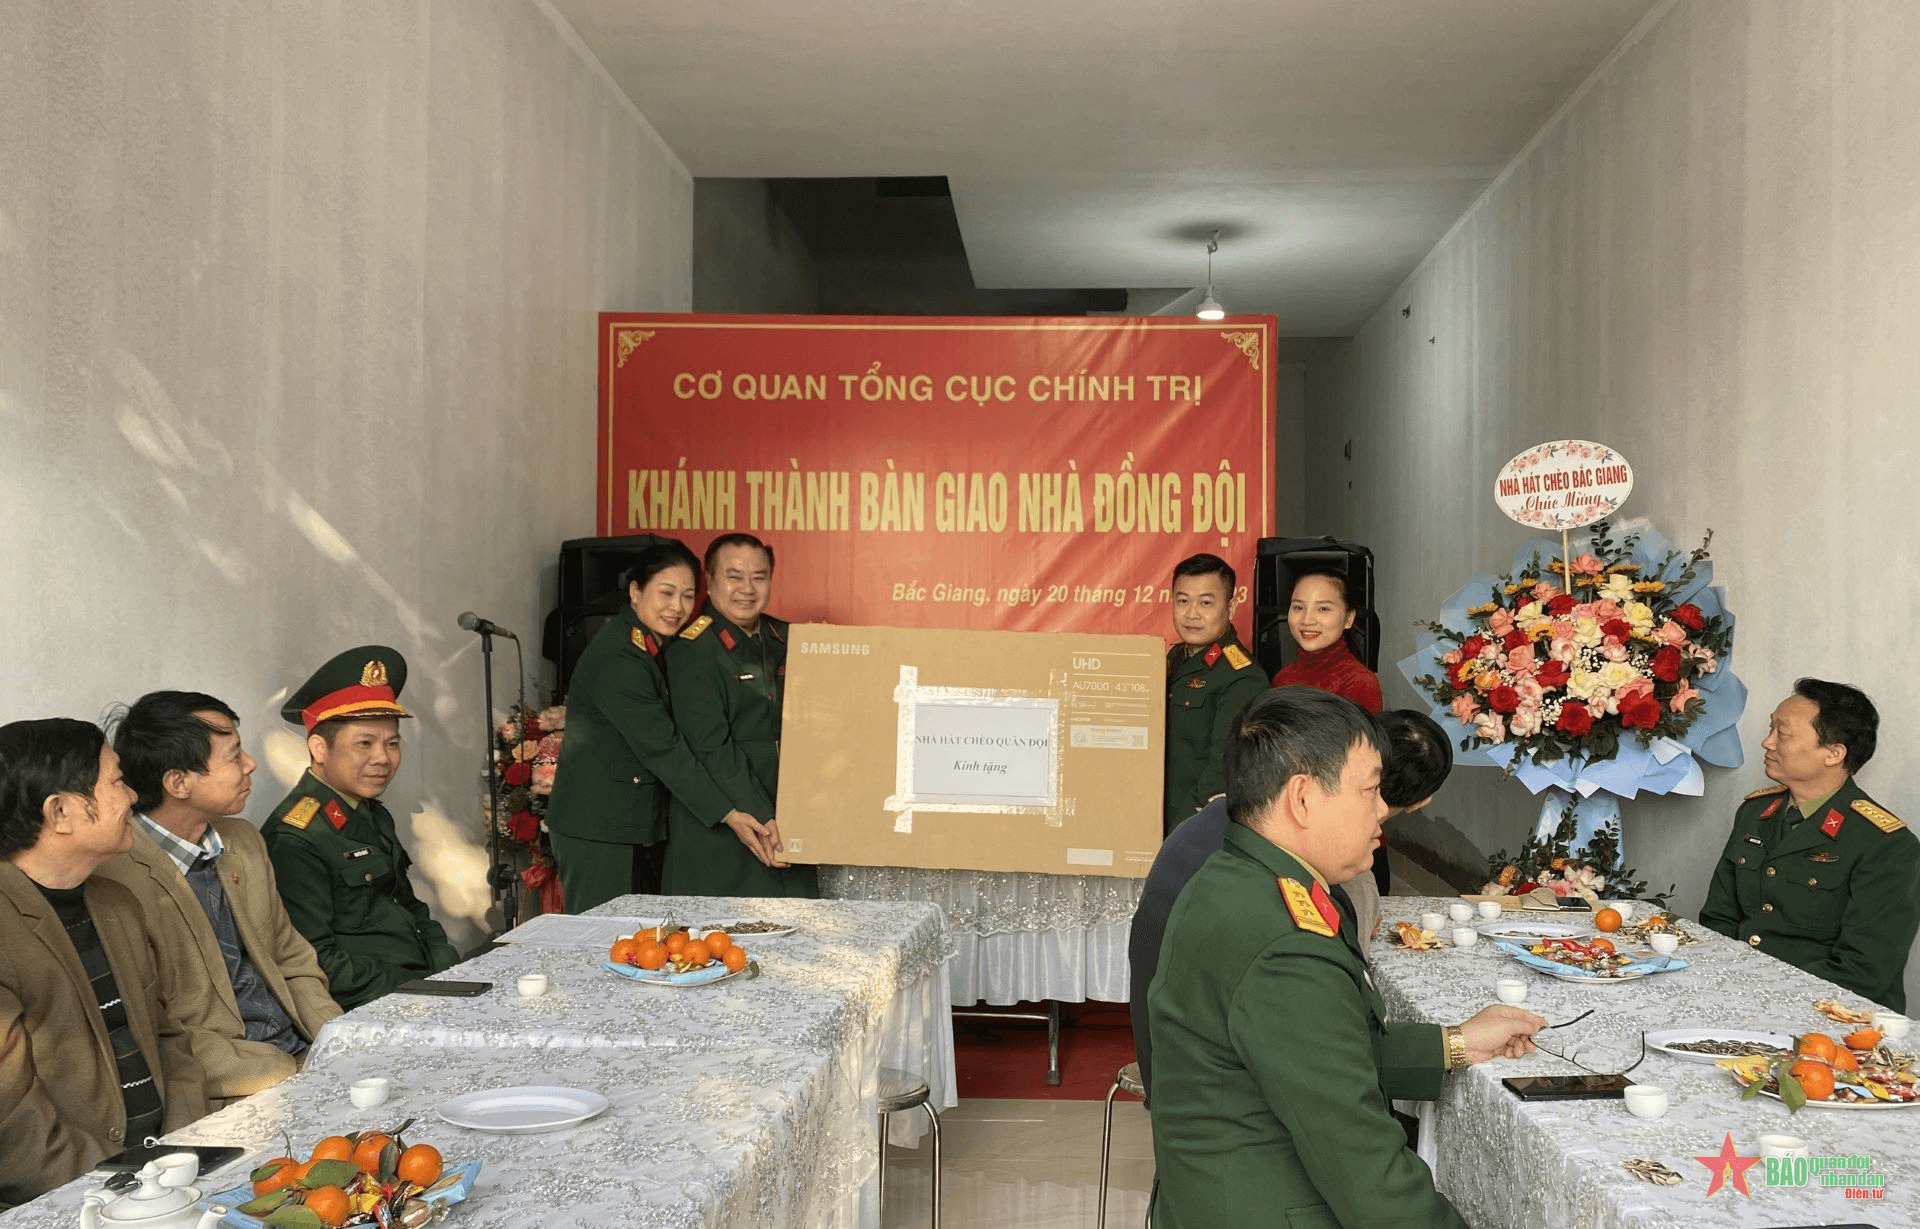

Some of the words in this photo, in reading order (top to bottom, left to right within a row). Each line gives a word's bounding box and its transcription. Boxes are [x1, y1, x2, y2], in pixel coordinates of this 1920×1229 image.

[673, 370, 723, 400] CƠ
[732, 374, 826, 401] QUAN
[838, 361, 933, 401] TỔNG
[945, 375, 1016, 407] CỤC
[1028, 369, 1134, 402] CHÍNH
[1147, 376, 1201, 406] TRỊ
[1500, 474, 1520, 497] NHÀ
[1522, 472, 1541, 494] HÁT
[1543, 468, 1569, 492] CHÈO
[1572, 464, 1593, 488] BẮC
[1595, 464, 1628, 486] GIANG
[628, 456, 736, 530] KHÁNH
[746, 457, 849, 531] THÀNH
[860, 458, 925, 532] BÀN
[935, 471, 1008, 533] GIAO
[1019, 459, 1084, 533] NHÀ
[1093, 451, 1182, 533] ĐỒNG
[1192, 459, 1246, 547] ĐỘI
[1525, 494, 1558, 511] Chúc
[892, 579, 927, 601] Bắc
[932, 583, 991, 607] Giang,
[996, 583, 1042, 607] ngày
[1046, 584, 1068, 603] 20
[1074, 584, 1127, 607] tháng
[1133, 585, 1154, 603] 12
[800, 642, 870, 656] SAMSUNG
[1072, 657, 1101, 670] UHD
[1072, 681, 1110, 691] AU7000
[953, 760, 980, 772] Kính
[982, 761, 1008, 774] tặng
